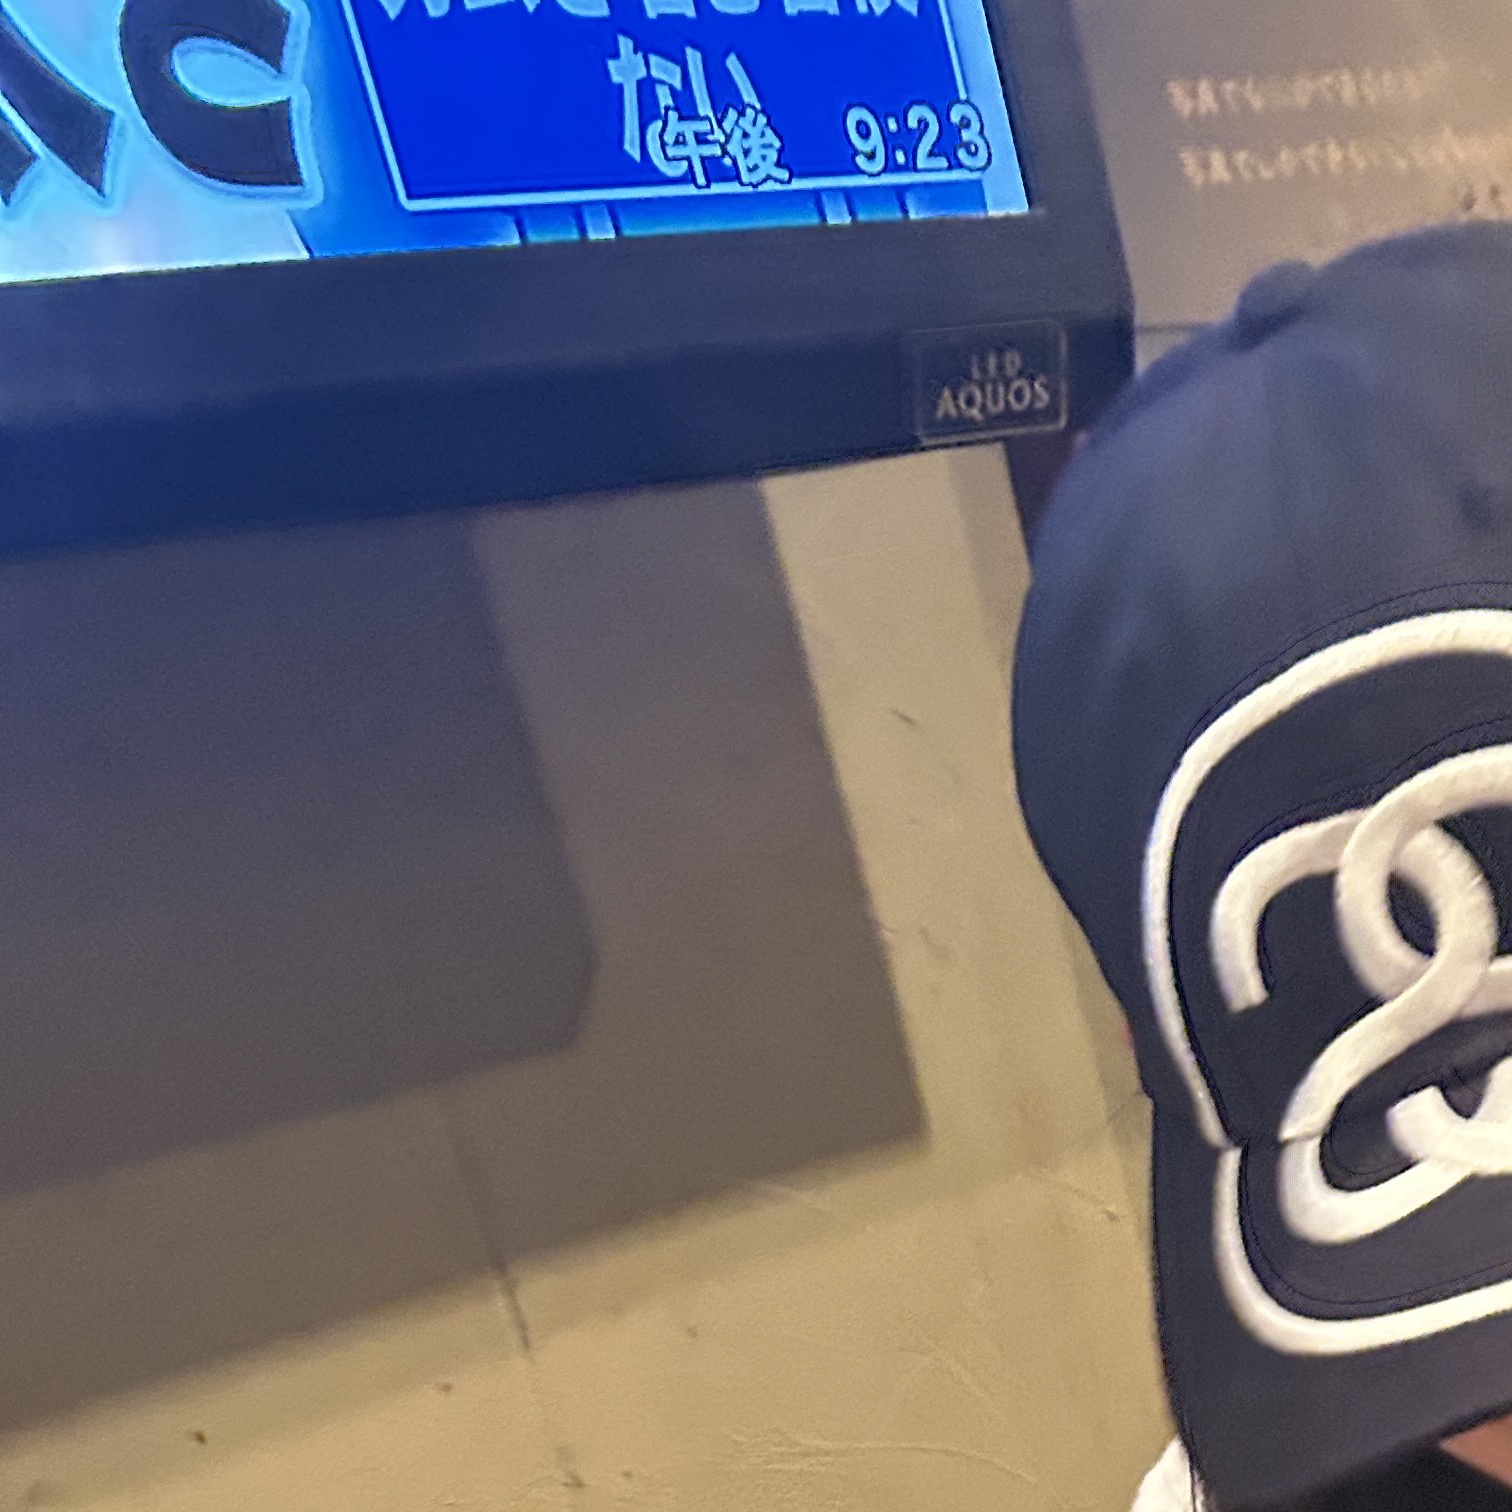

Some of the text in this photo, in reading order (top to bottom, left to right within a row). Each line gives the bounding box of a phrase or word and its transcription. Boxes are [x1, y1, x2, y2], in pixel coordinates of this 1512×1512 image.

[661, 102, 992, 188] 午後 9:23
[936, 375, 1050, 421] AQUOS
